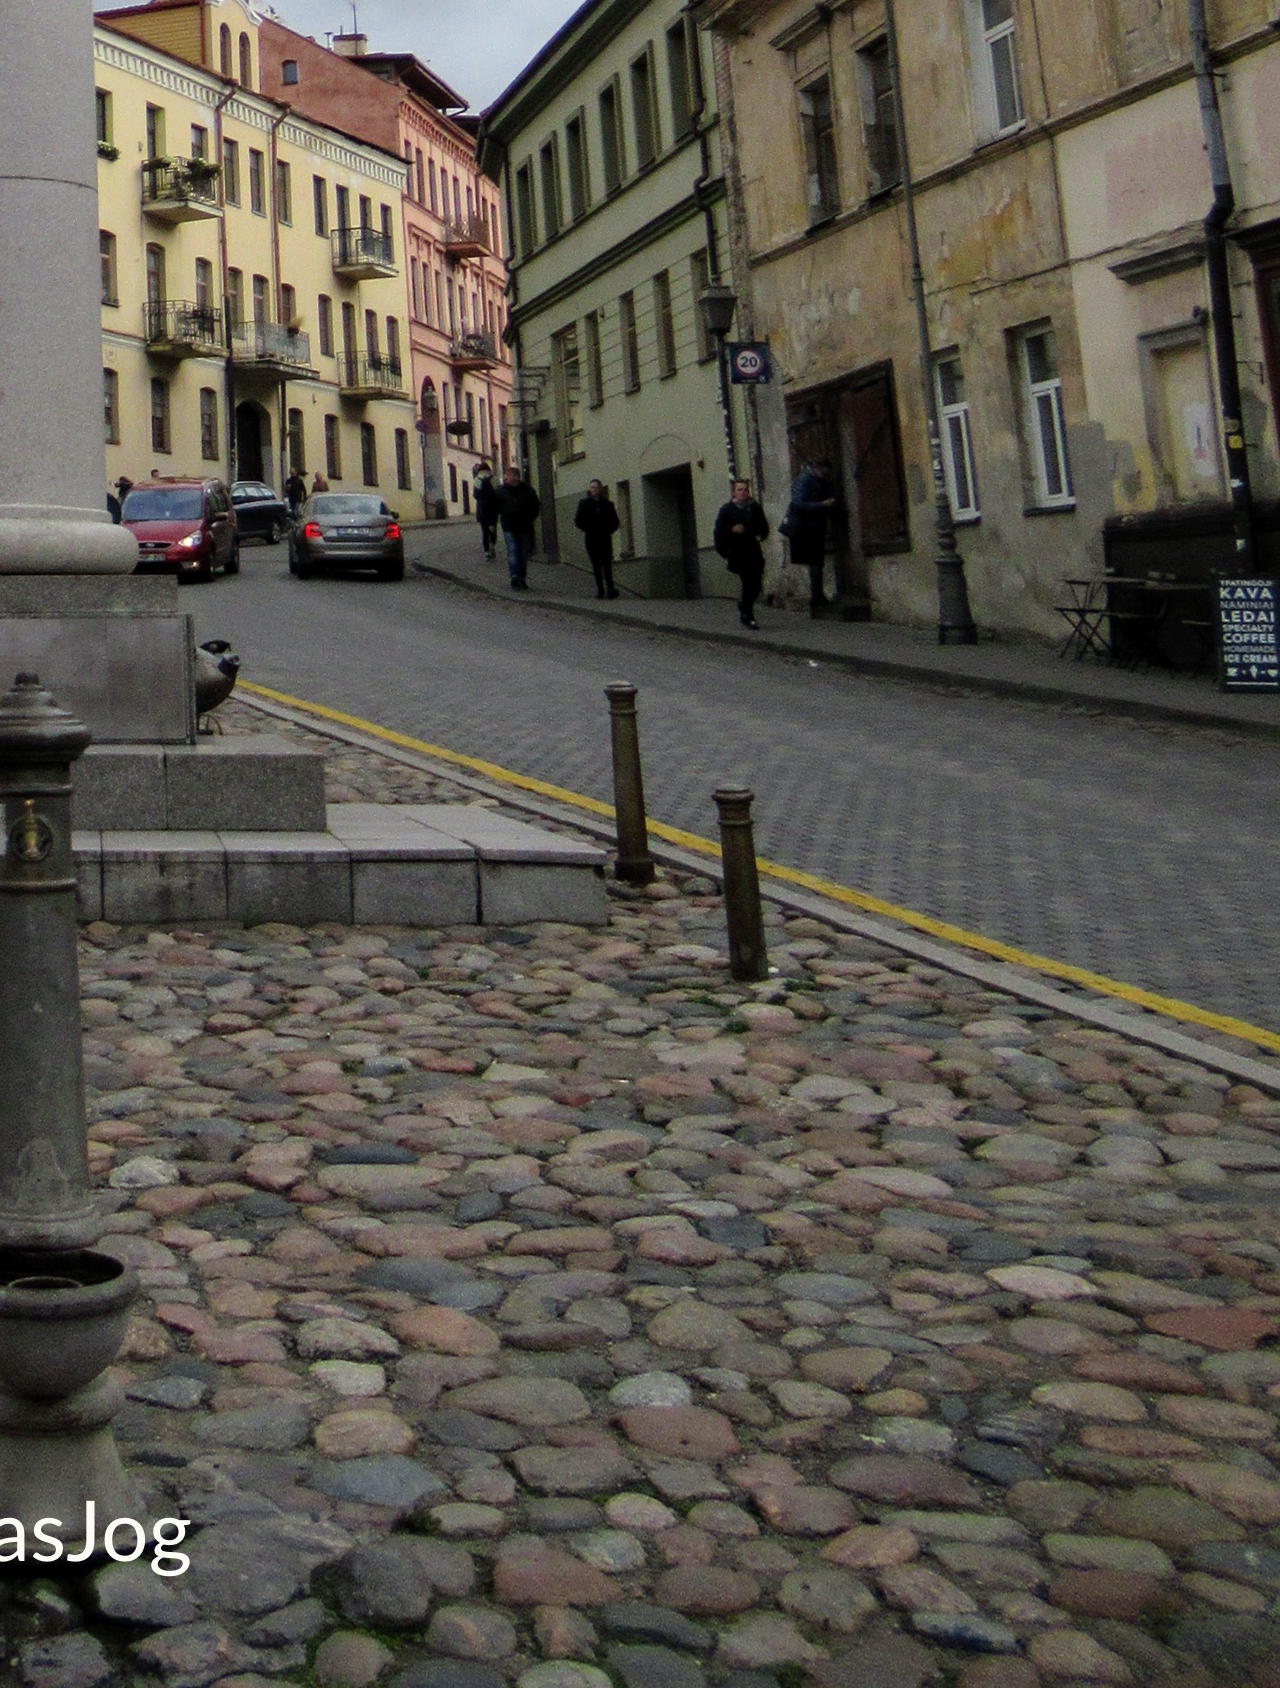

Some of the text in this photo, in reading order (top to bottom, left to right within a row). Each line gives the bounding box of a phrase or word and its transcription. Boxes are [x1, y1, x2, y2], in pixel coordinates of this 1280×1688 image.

[740, 356, 758, 368] 20
[1220, 587, 1273, 599] KAVA
[1220, 601, 1274, 609] NAMINIAI
[1221, 611, 1275, 623] LEDAI
[1222, 624, 1274, 632] SPECIALTY
[1222, 633, 1276, 643] COFFEE
[1223, 645, 1276, 653] HOMEMADE
[1223, 654, 1278, 663] ICE CREAM
